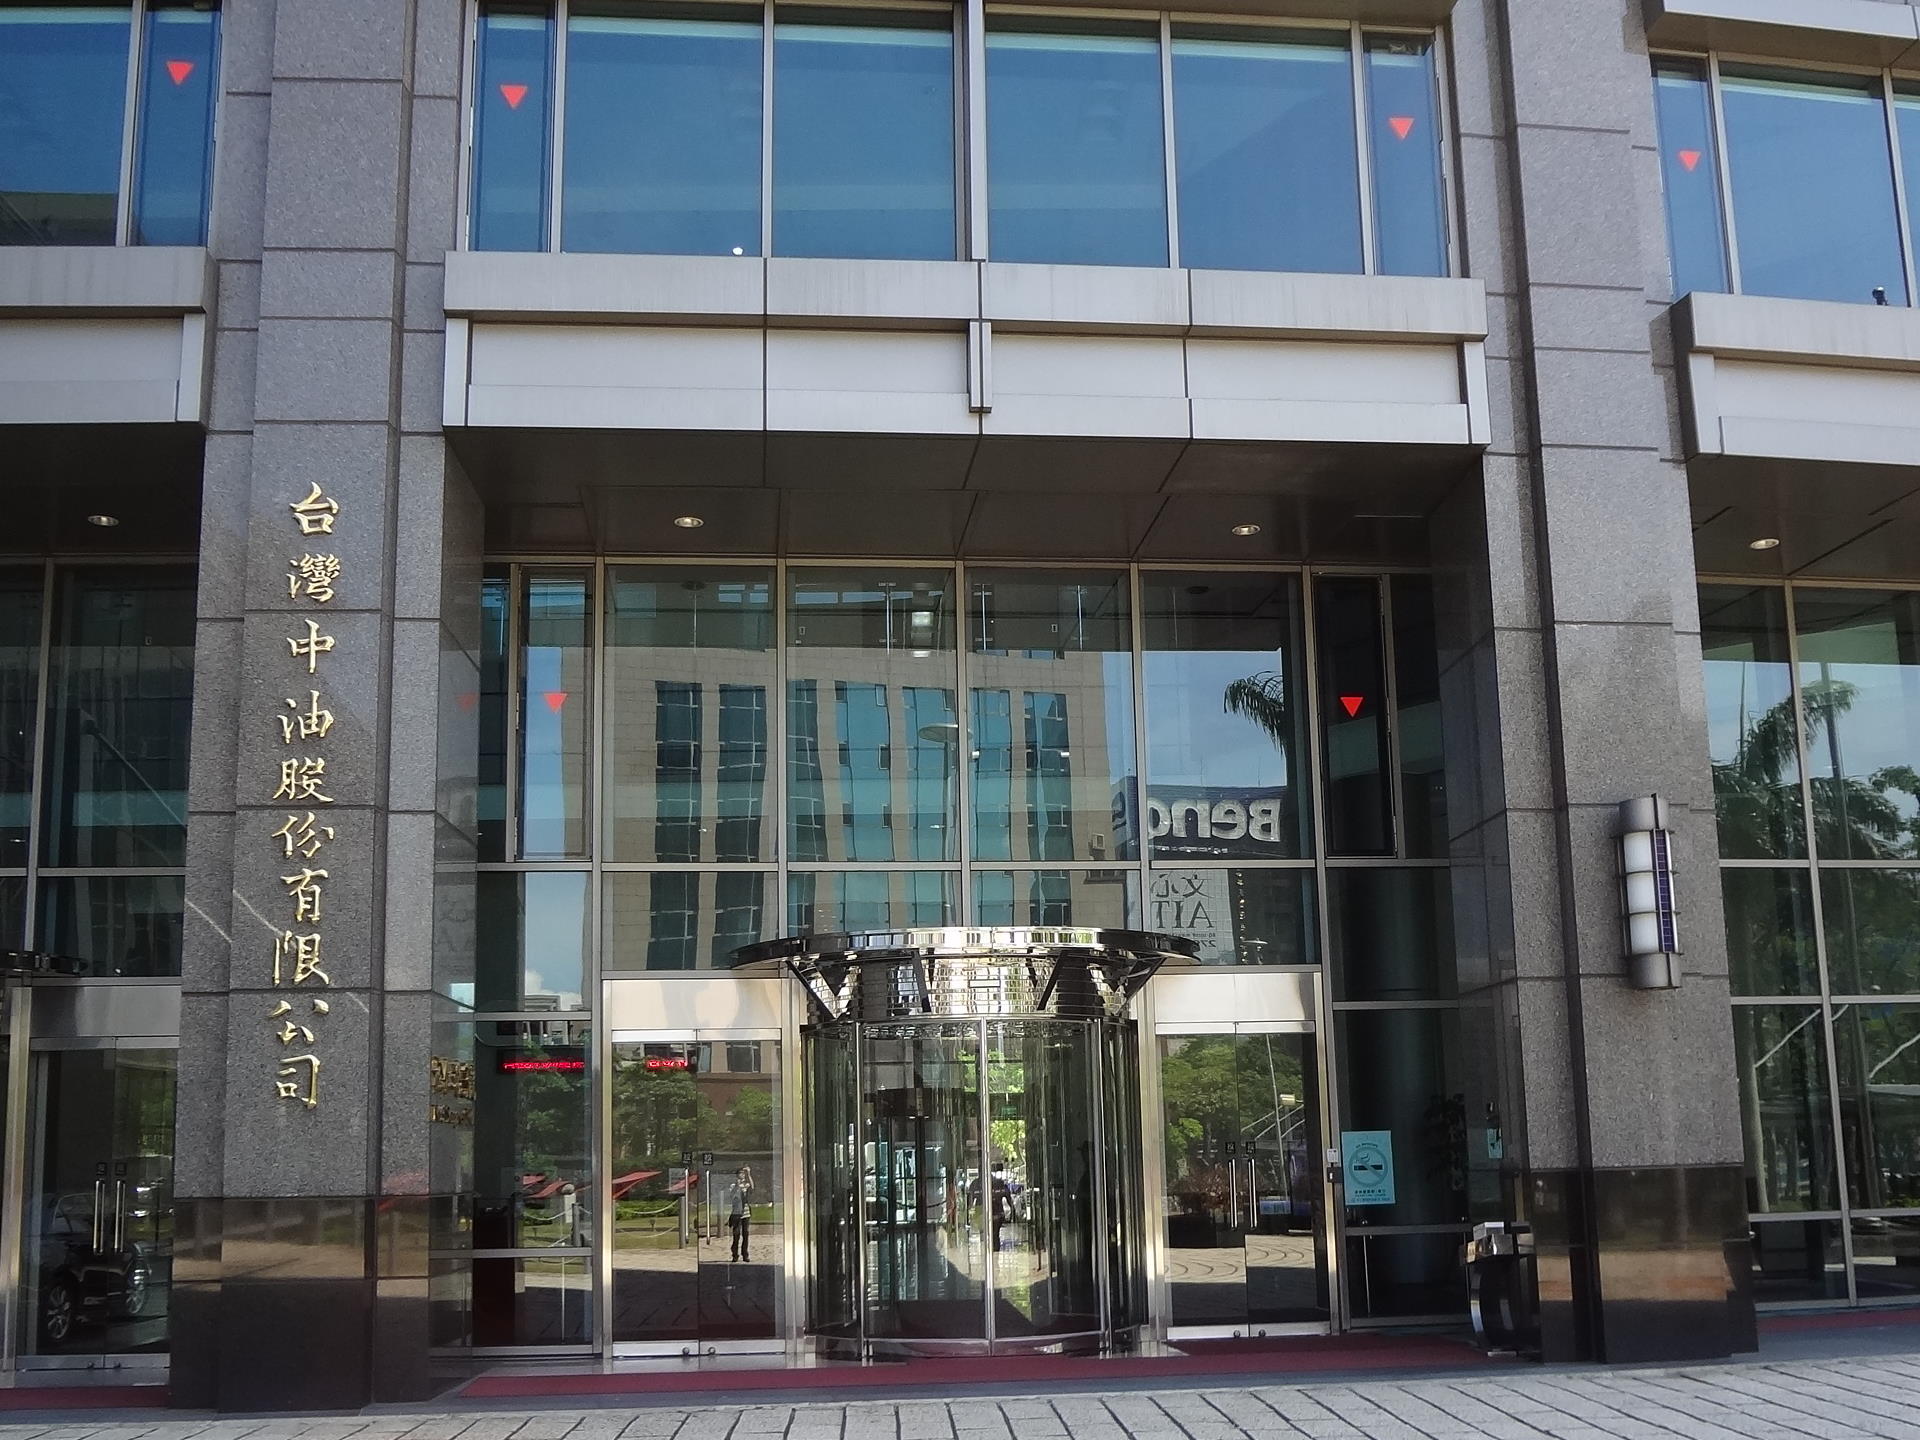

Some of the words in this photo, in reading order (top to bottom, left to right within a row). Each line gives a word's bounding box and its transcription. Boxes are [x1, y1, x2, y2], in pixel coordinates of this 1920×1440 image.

[269, 481, 342, 1111] 台灣中油股份有限公司
